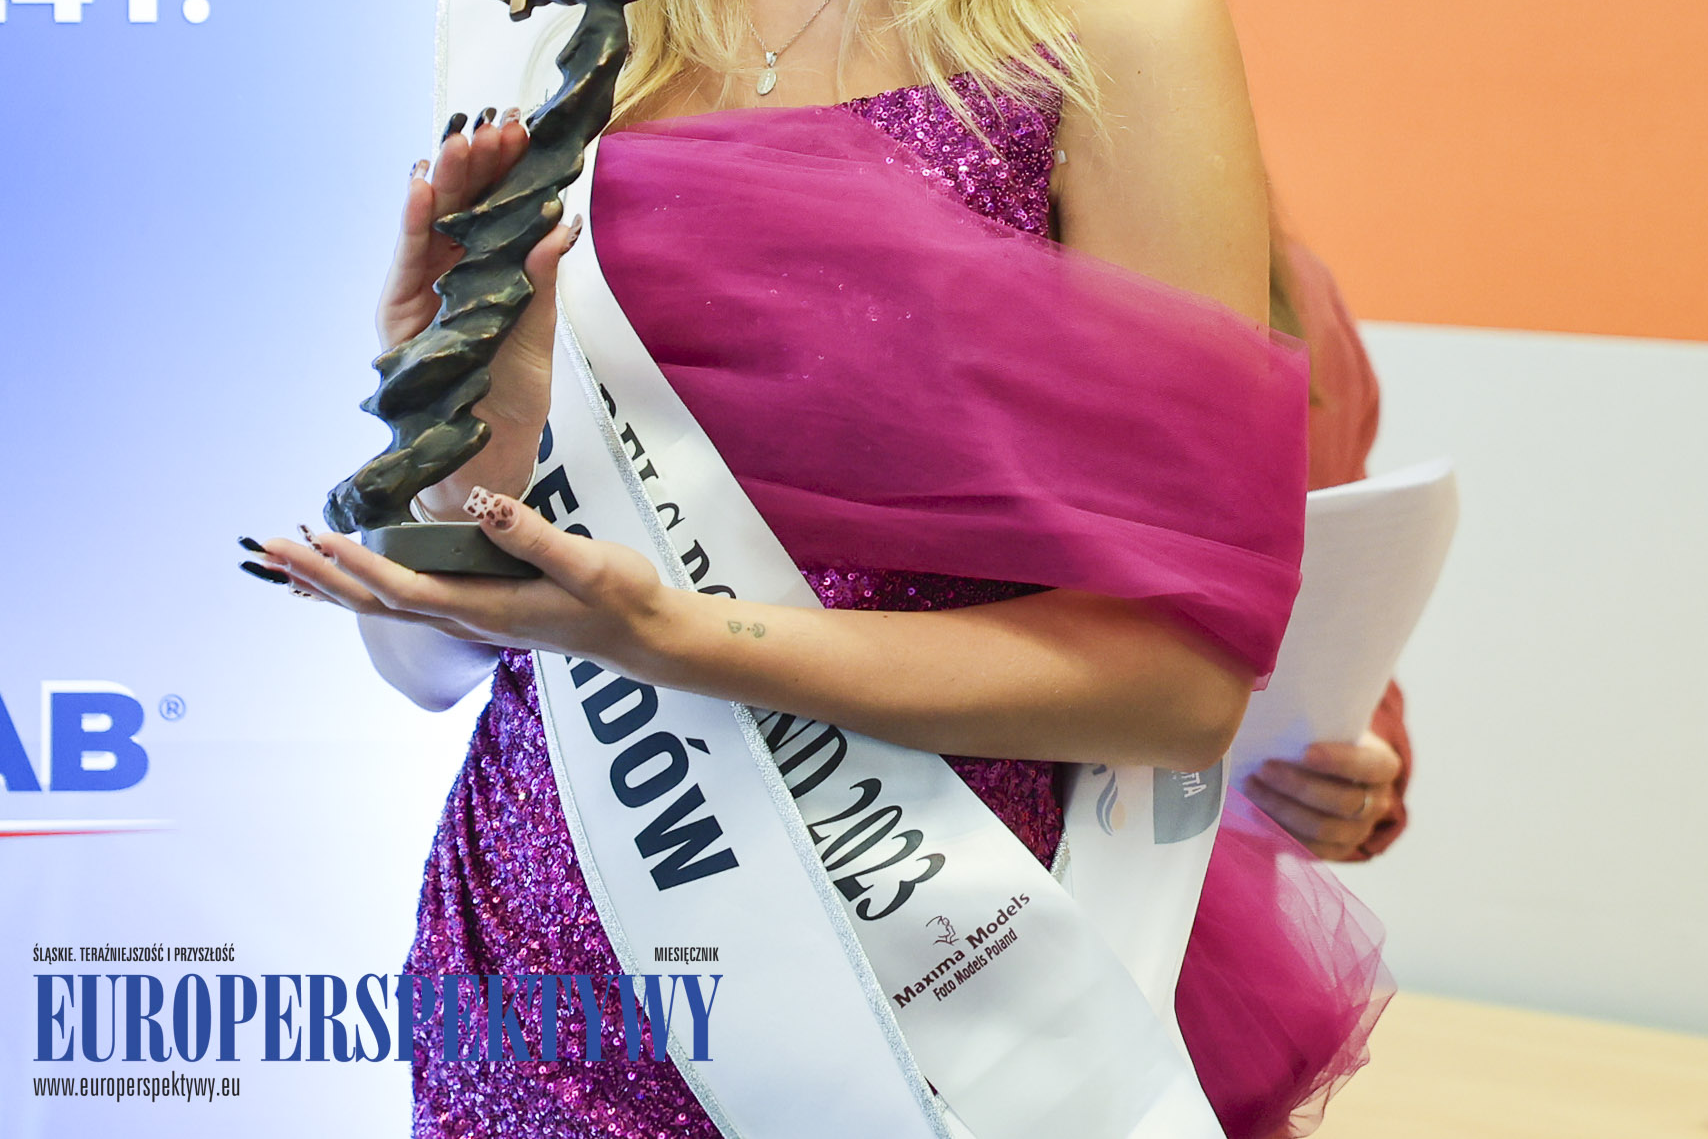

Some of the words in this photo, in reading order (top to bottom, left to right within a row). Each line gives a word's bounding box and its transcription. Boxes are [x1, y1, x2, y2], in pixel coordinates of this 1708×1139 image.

[807, 777, 946, 921] 2023
[892, 948, 965, 1009] Maxima
[965, 892, 1031, 950] Models
[932, 979, 957, 1002] Foto
[953, 954, 988, 986] Models
[984, 926, 1018, 961] Poland
